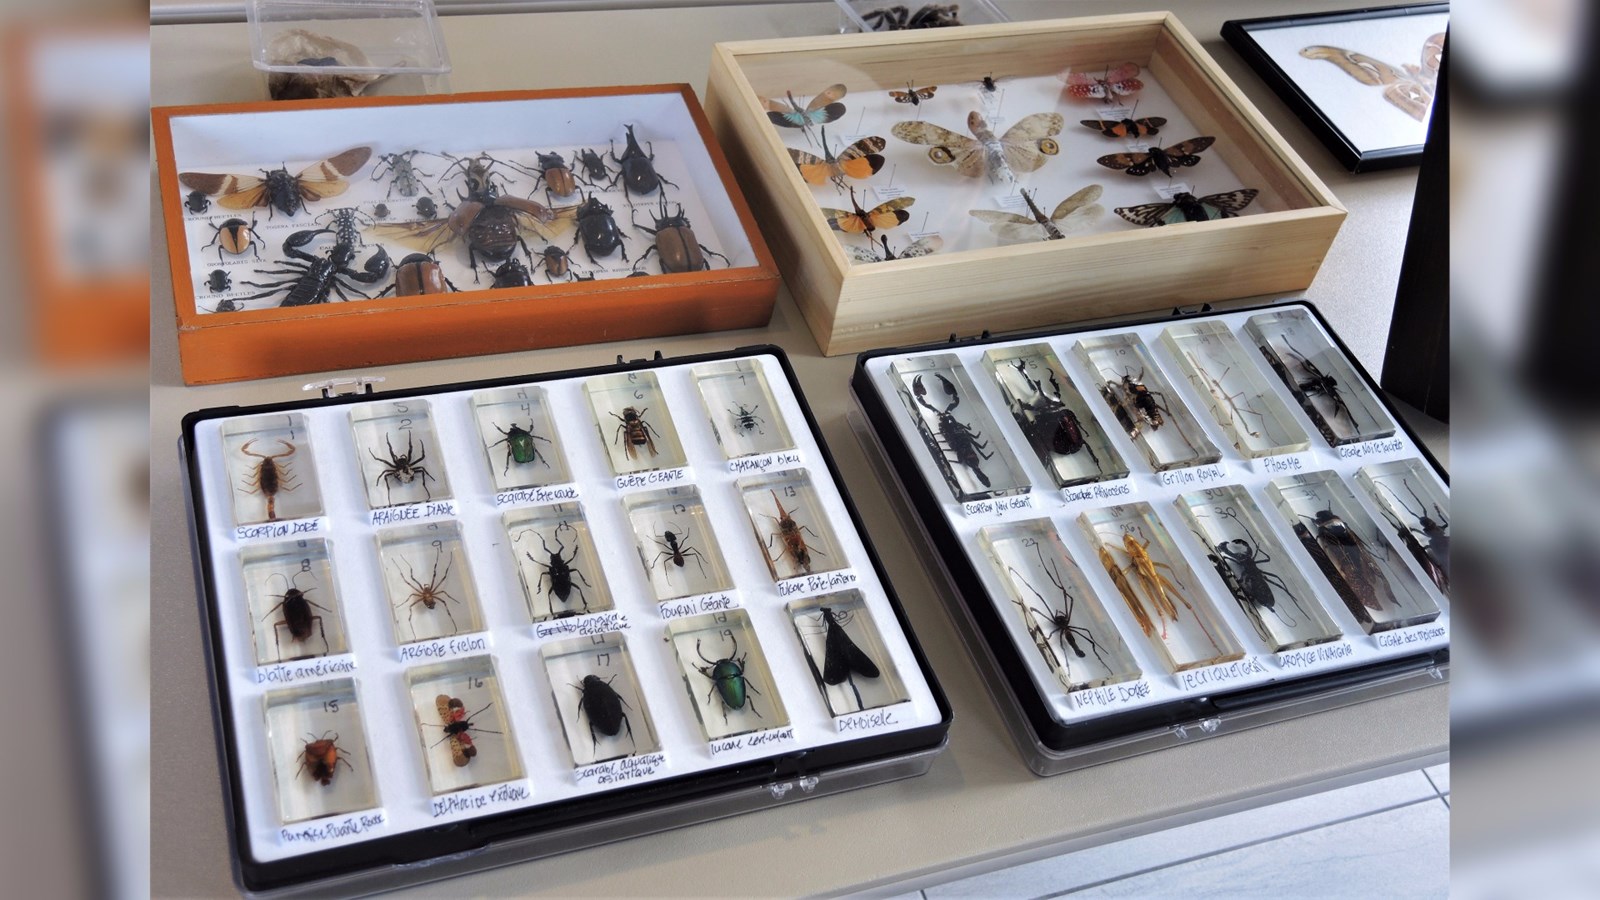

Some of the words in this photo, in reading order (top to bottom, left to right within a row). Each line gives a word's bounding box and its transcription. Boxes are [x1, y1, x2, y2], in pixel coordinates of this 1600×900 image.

[633, 389, 644, 400] 6
[520, 403, 531, 416] 4
[398, 418, 413, 431] 2
[784, 485, 797, 497] 13
[431, 539, 443, 553] 9
[301, 558, 311, 572] 8
[597, 652, 611, 667] 17
[468, 676, 483, 690] 16
[323, 699, 339, 714] 15
